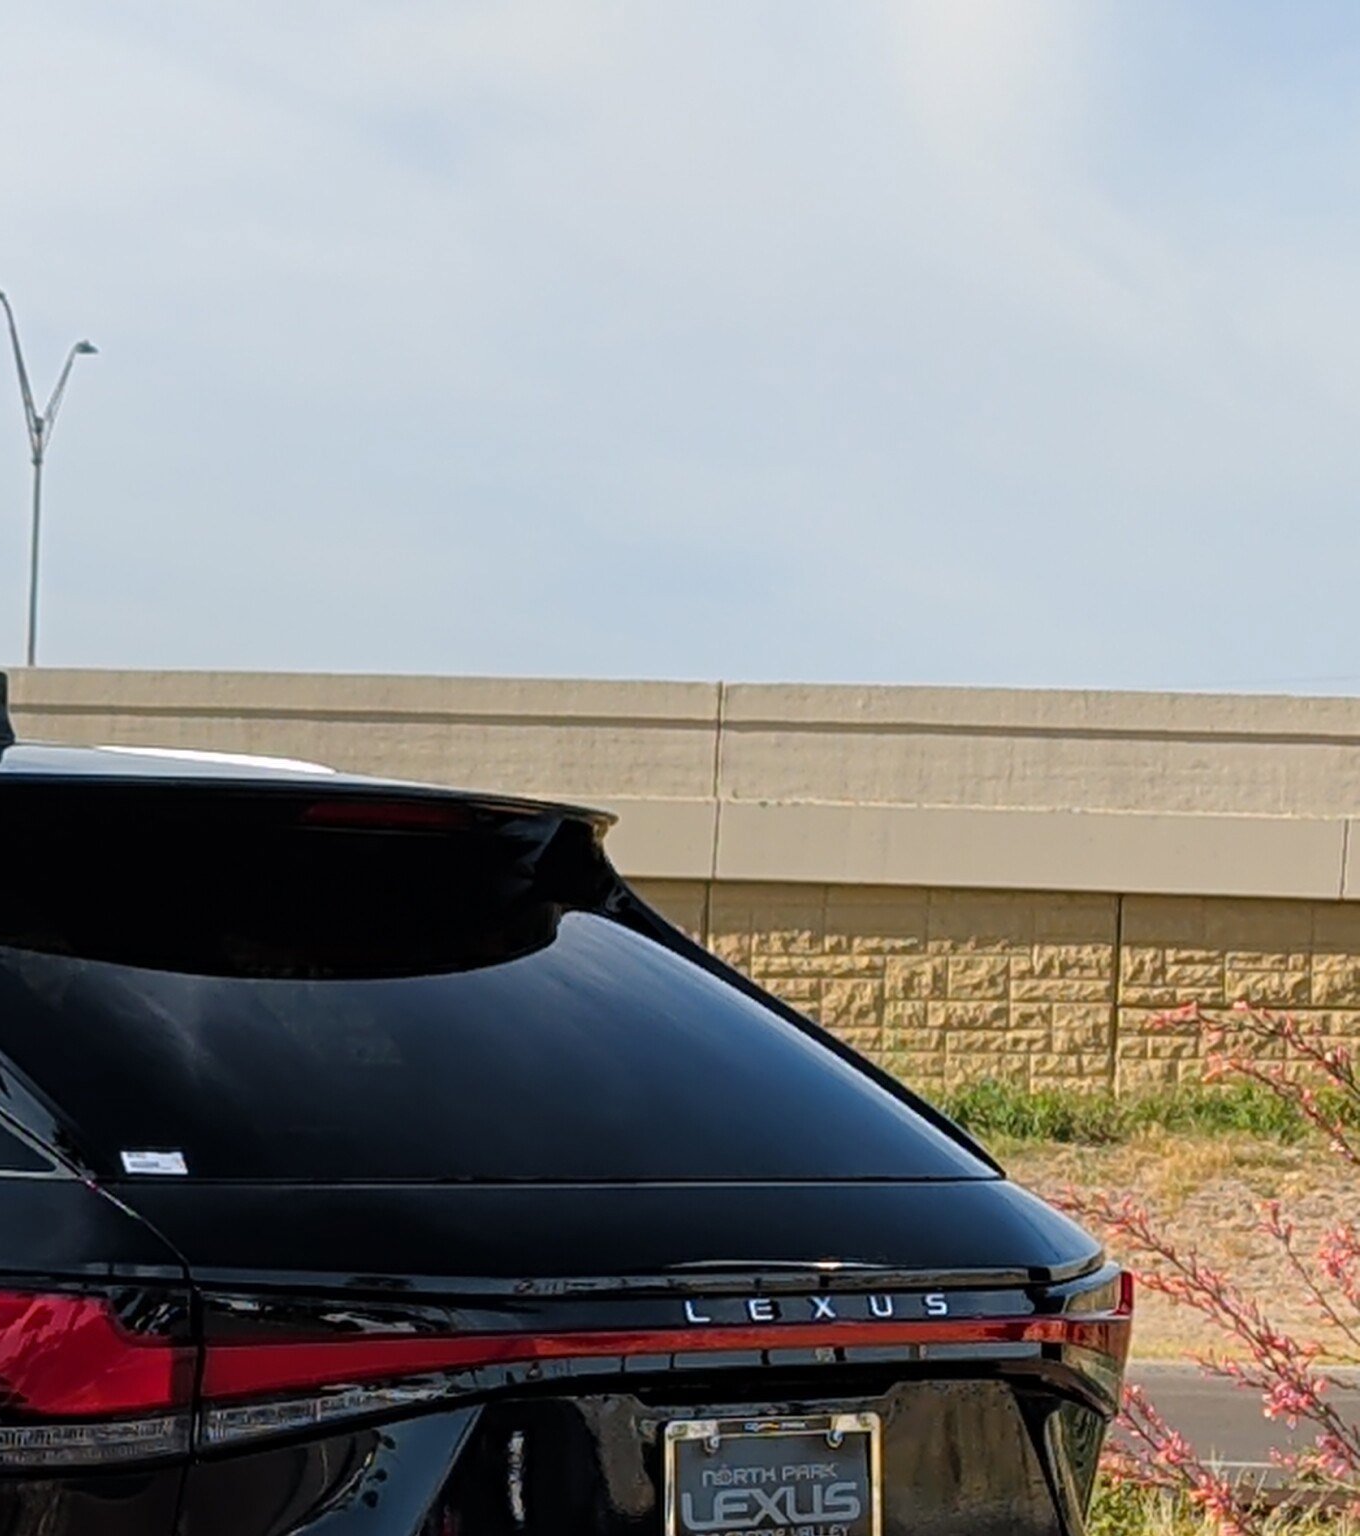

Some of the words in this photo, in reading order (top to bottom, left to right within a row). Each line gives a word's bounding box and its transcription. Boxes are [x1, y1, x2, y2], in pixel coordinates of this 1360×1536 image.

[685, 1293, 948, 1323] LEXUS
[702, 1465, 776, 1488] NORTH
[782, 1463, 838, 1481] PARK
[681, 1482, 861, 1531] LEXUS
